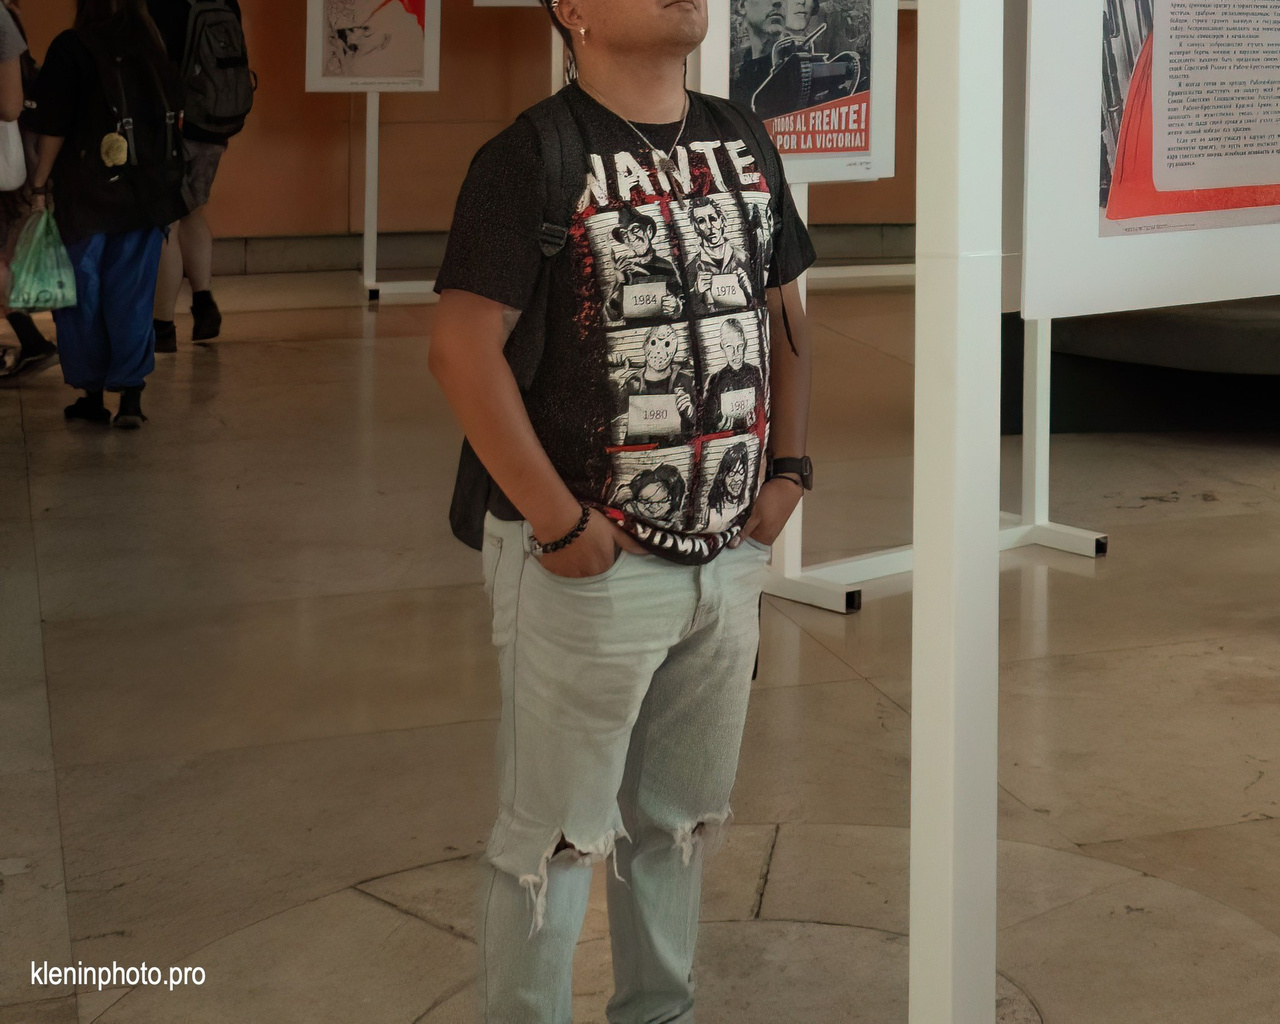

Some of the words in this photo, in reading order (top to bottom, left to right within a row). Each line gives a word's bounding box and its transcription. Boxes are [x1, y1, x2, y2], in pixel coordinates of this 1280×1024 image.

[796, 114, 807, 132] AL
[809, 103, 867, 131] FRENTE!
[776, 134, 797, 150] POR
[801, 134, 812, 149] LA
[816, 132, 866, 149] VICTORIA!
[716, 285, 737, 297] 1978
[632, 294, 658, 306] 1984
[642, 409, 668, 421] 1980
